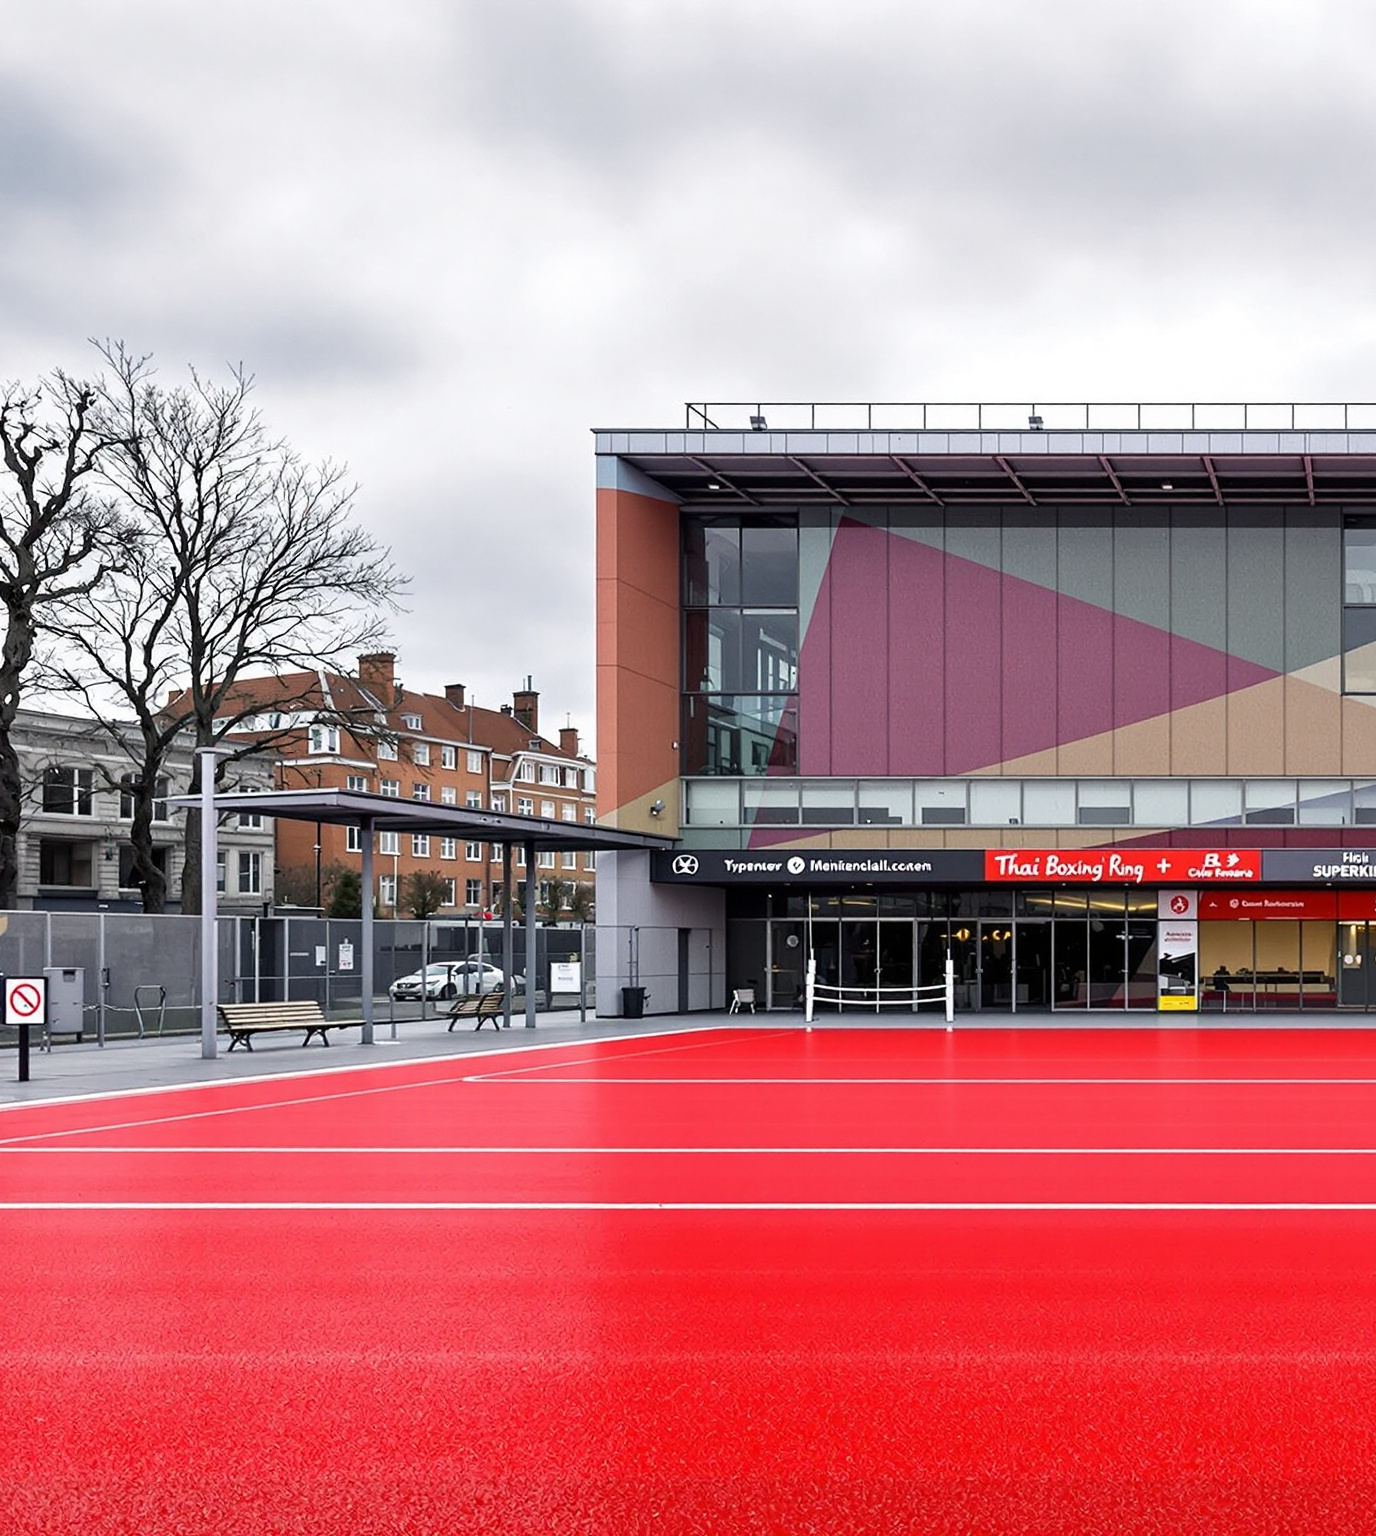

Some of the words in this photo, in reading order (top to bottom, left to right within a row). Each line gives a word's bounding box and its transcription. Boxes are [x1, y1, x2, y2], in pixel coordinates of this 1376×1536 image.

[994, 853, 1040, 876] Thai
[1045, 854, 1105, 882] Boxing
[1109, 854, 1144, 883] Ring
